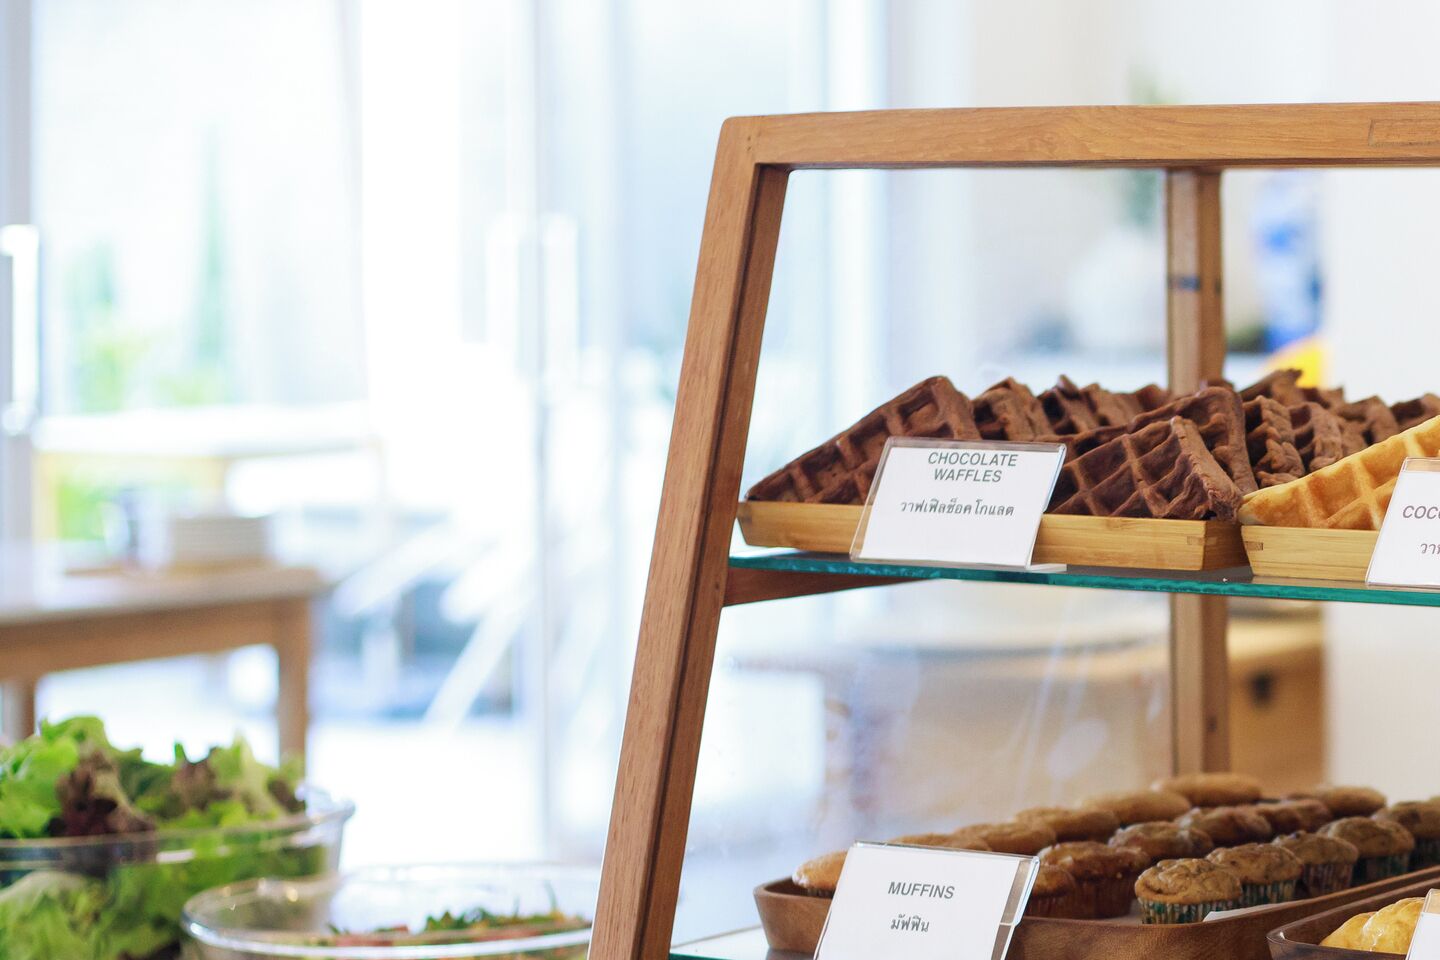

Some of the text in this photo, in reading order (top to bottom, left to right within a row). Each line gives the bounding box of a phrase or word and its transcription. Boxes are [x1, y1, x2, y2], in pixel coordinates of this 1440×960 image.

[927, 451, 1019, 467] CHOCOLATE
[933, 468, 1003, 483] WAFFLES
[887, 881, 956, 900] MUFFINS
